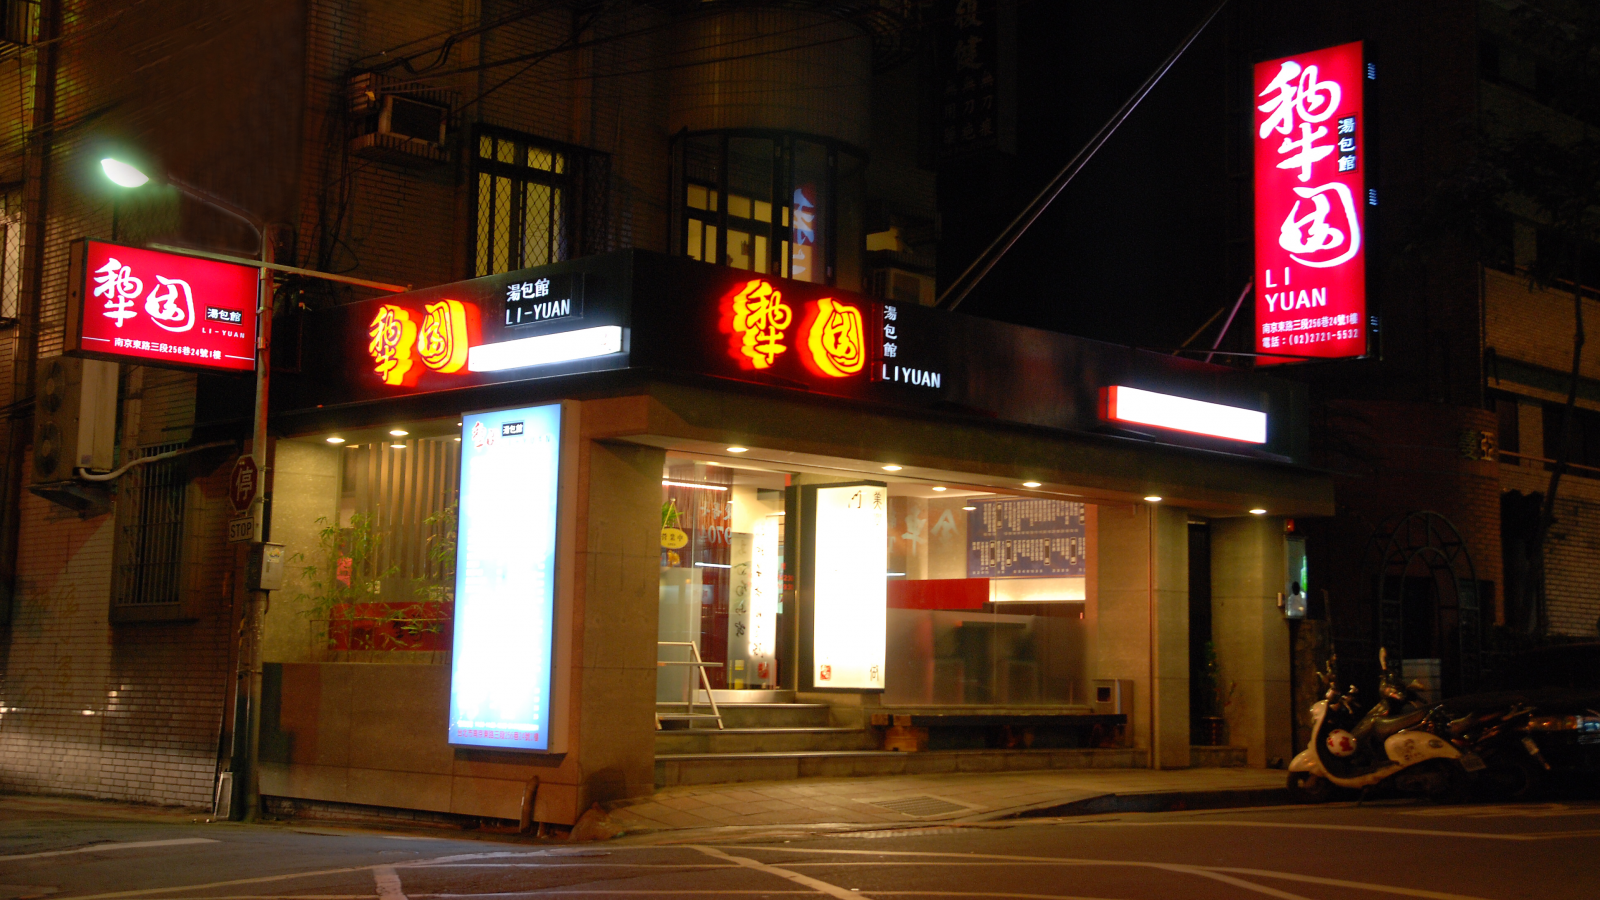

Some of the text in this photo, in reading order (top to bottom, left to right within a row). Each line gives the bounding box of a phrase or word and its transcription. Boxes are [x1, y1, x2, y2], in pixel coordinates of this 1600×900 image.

[1337, 117, 1356, 173] 湯包館
[1265, 266, 1290, 289] LI
[506, 278, 550, 302] 湯包館
[1264, 287, 1327, 313] YUAN
[207, 307, 242, 323] 湯包館
[883, 304, 898, 359] 湯包館
[114, 337, 222, 360] 南京東路三段256巷24號1樓
[235, 466, 254, 502] 停
[230, 521, 252, 539] STOP
